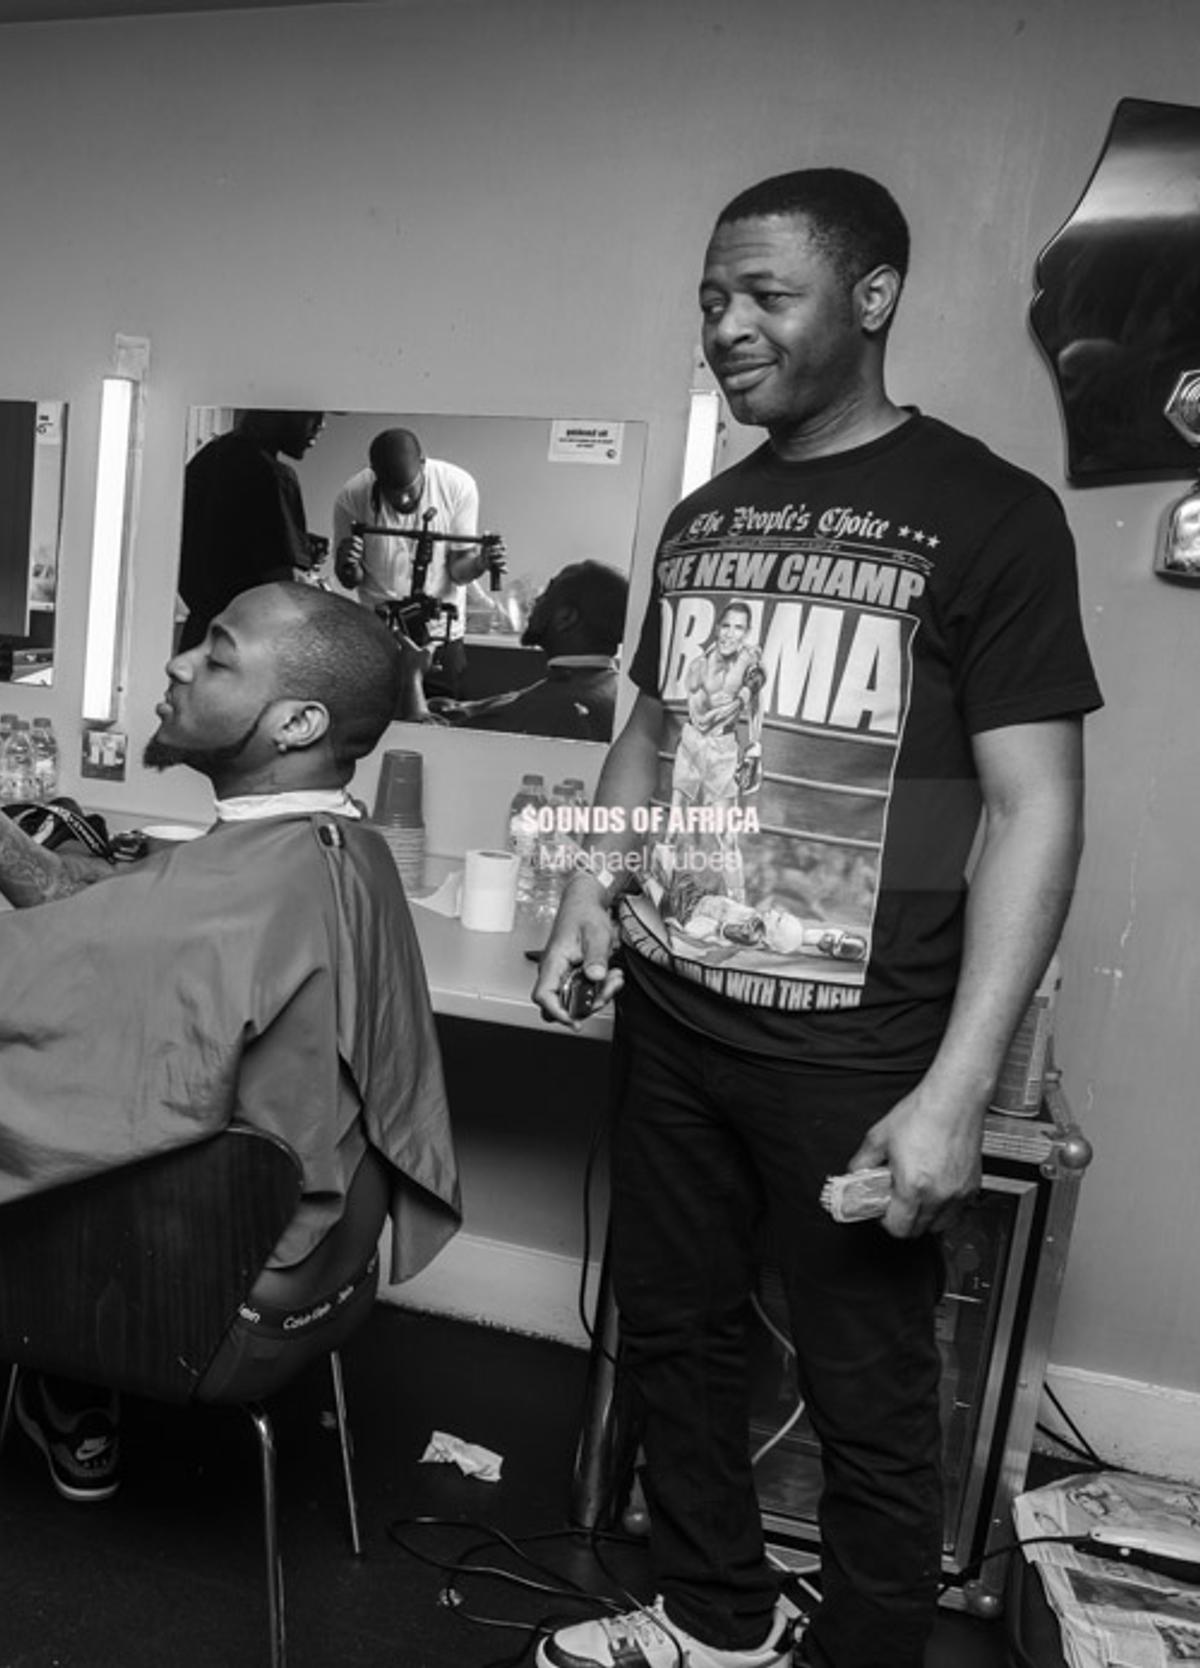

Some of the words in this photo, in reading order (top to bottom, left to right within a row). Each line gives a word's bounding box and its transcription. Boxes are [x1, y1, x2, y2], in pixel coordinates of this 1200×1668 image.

[728, 504, 811, 538] People's
[815, 507, 890, 539] Choice
[692, 551, 779, 590] NEW
[776, 553, 926, 610] CHAMP
[726, 969, 777, 1008] WITH
[778, 978, 815, 1012] THE
